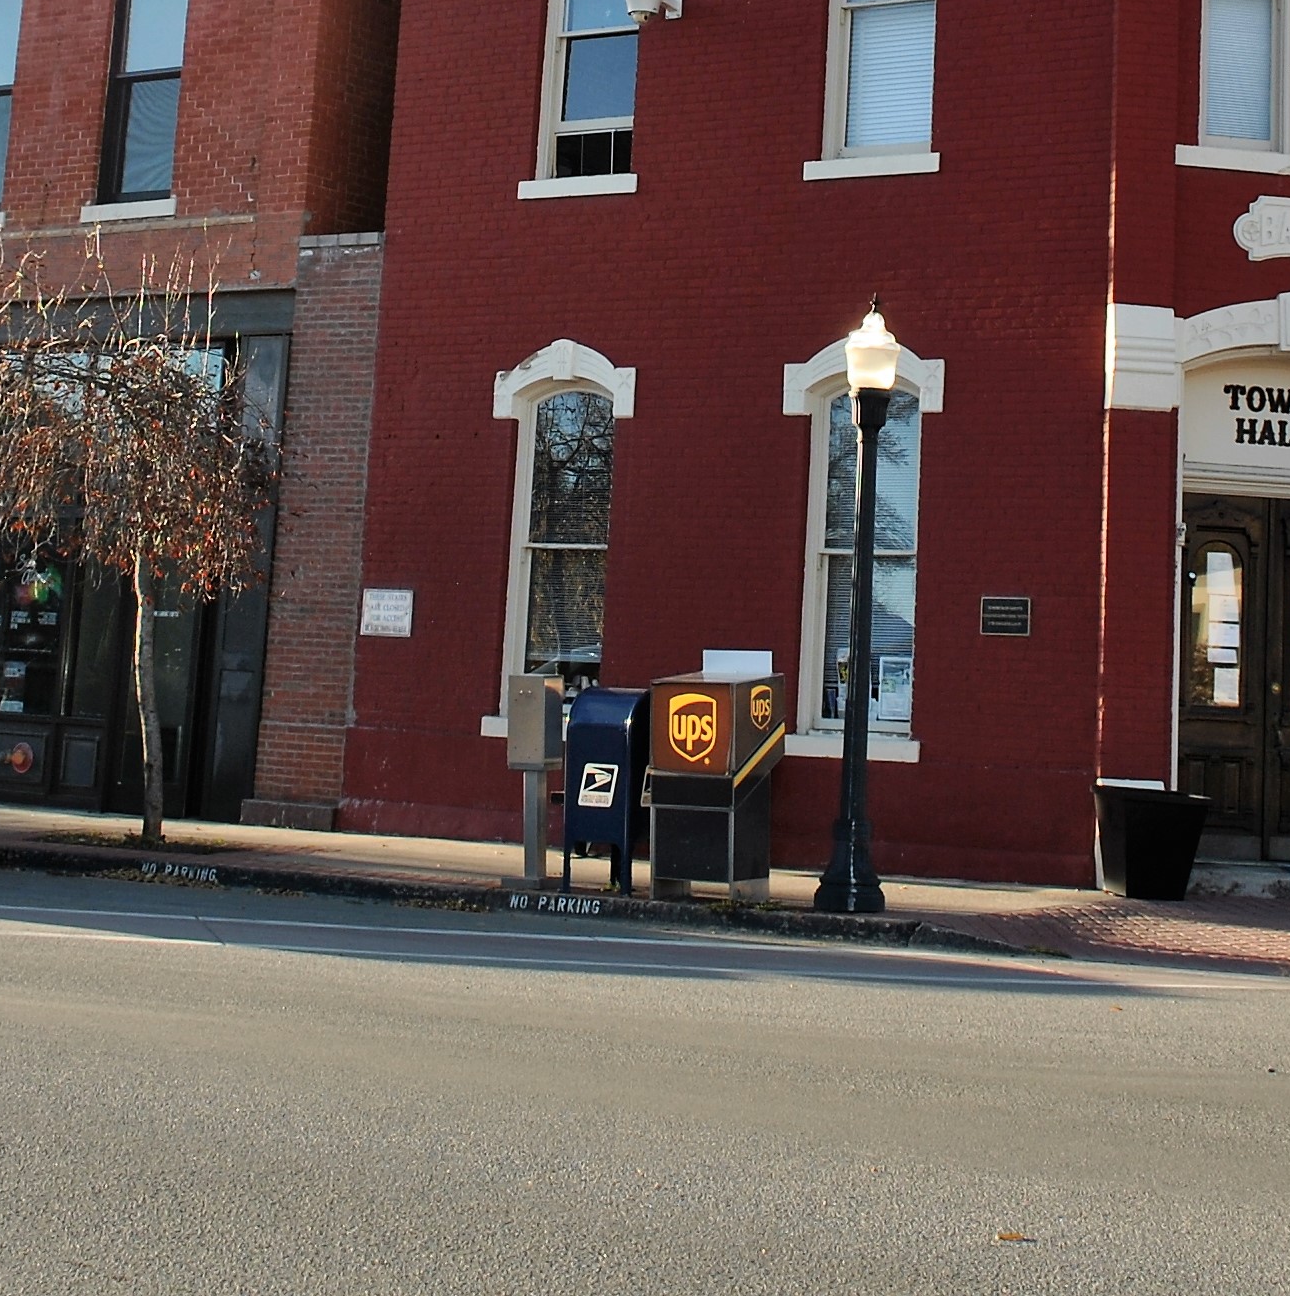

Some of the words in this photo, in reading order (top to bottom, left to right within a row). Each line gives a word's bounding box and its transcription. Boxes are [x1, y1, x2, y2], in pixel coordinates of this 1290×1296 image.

[752, 699, 770, 722] ups
[672, 714, 713, 751] ups
[141, 863, 157, 875] NO
[165, 864, 217, 882] PARKING
[510, 894, 529, 910] NO
[538, 896, 601, 914] PARKING
